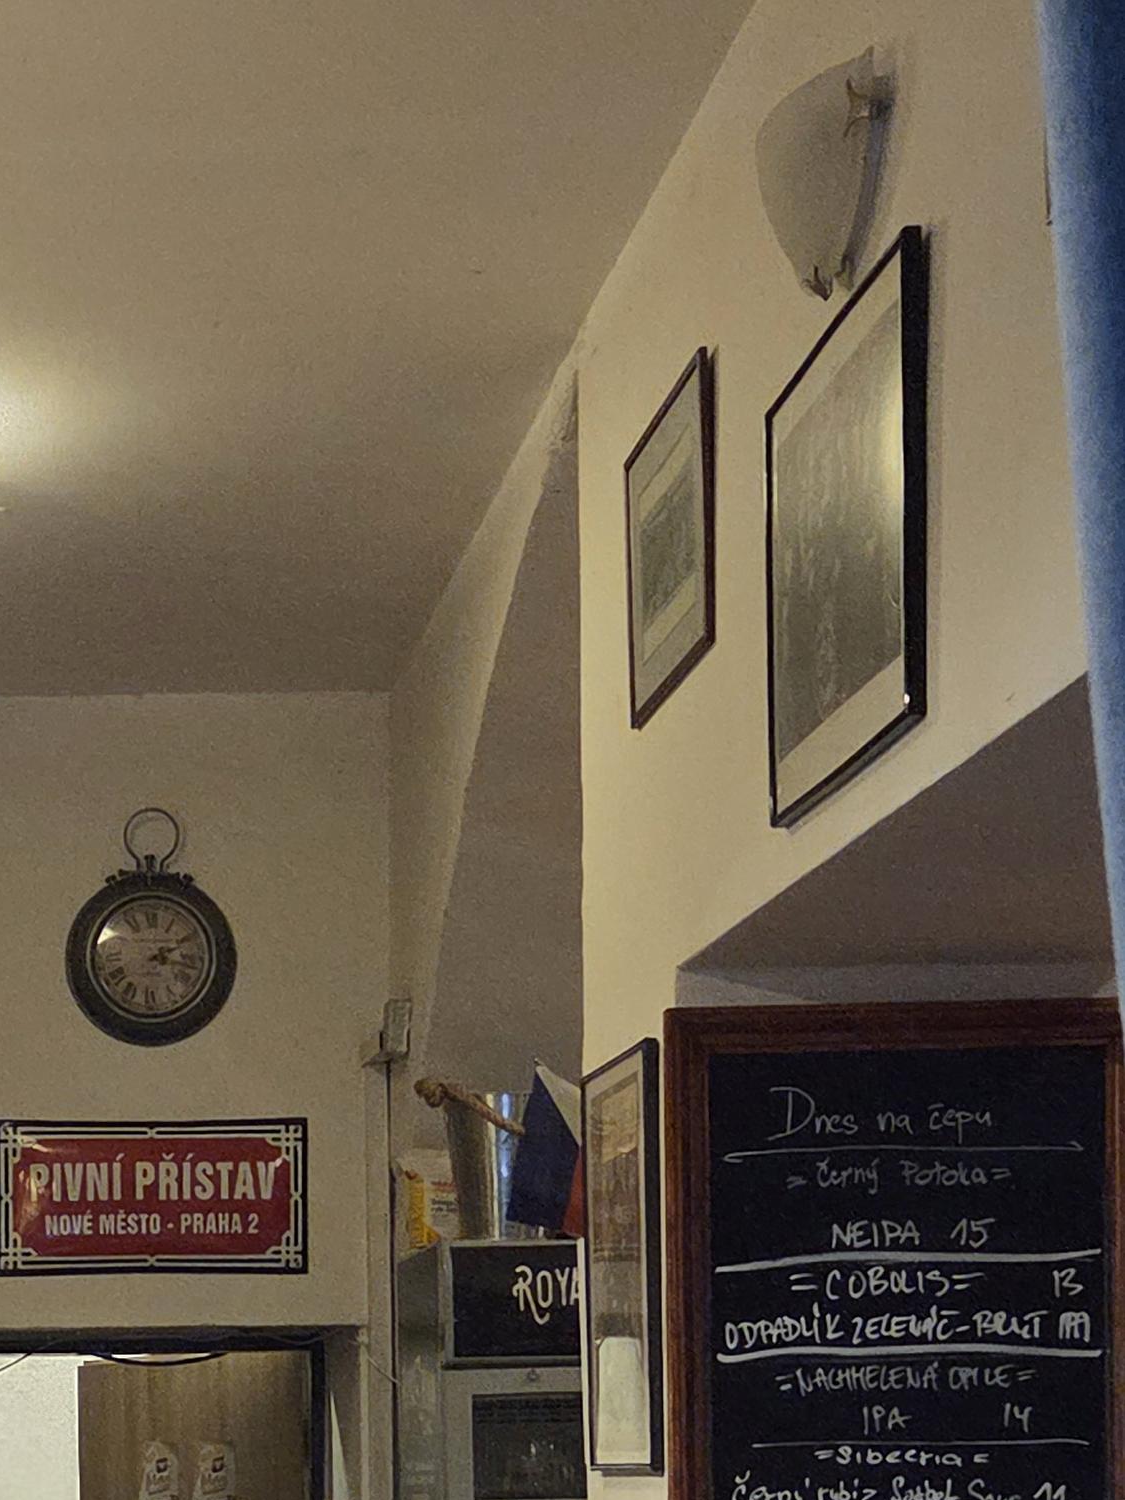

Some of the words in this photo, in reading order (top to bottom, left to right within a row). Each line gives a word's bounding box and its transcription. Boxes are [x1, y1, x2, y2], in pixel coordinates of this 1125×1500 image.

[768, 1086, 859, 1141] Dnes
[877, 1111, 913, 1135] na
[29, 1152, 124, 1202] PIVNÍ
[135, 1152, 276, 1201] PŘÍSTAV
[44, 1209, 92, 1236] NOVÉ
[99, 1208, 161, 1235] MĚSTO
[180, 1212, 242, 1234] PRAHA
[248, 1212, 259, 1234] 2
[831, 1219, 920, 1248] NEIPA
[949, 1217, 996, 1248] 15
[862, 1404, 912, 1435] IPA
[1003, 1402, 1033, 1433] 14
